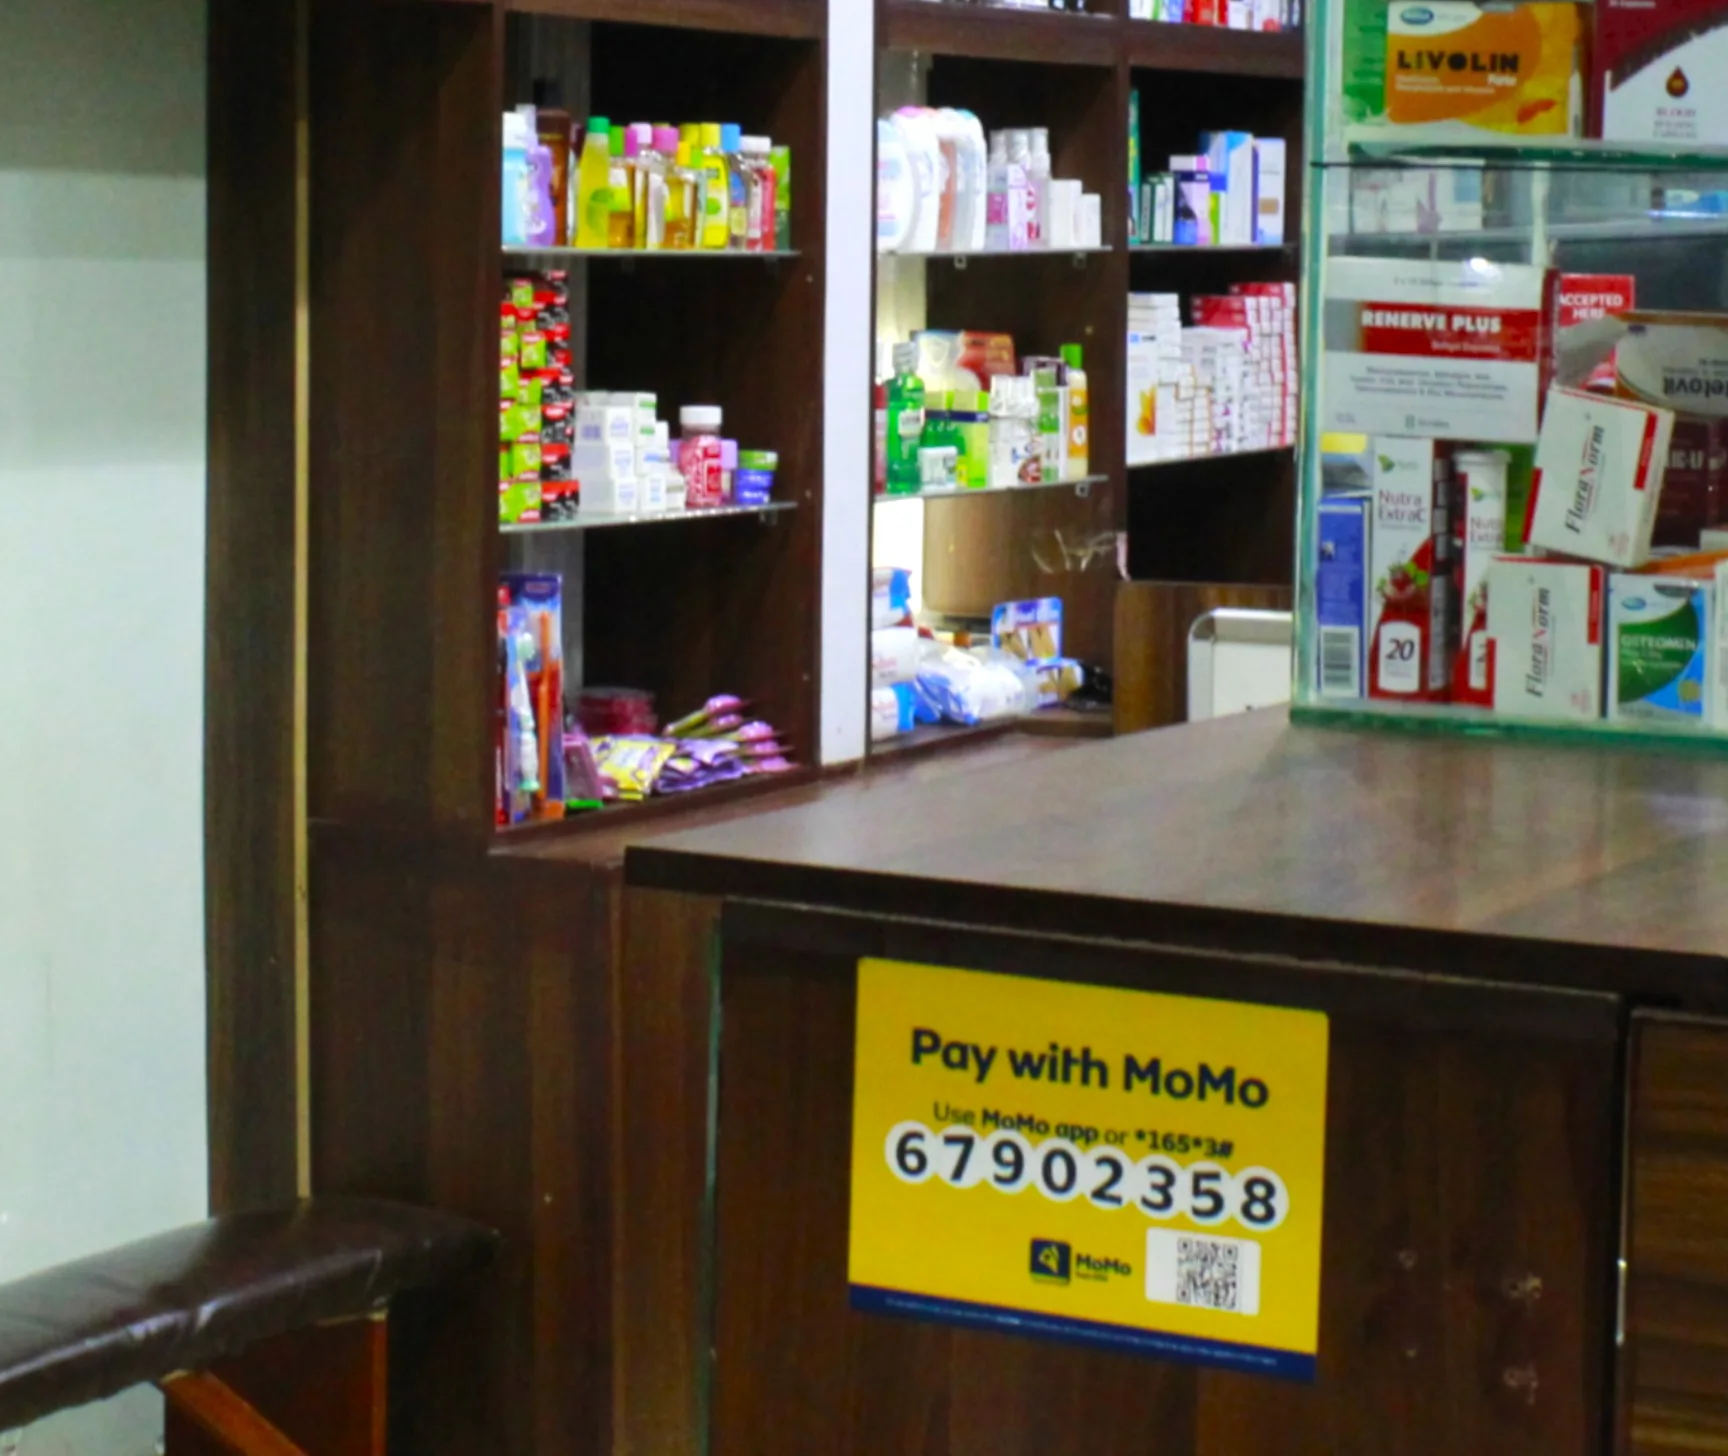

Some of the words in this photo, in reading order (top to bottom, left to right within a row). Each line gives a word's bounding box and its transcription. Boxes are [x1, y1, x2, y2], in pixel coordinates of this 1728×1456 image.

[1397, 49, 1520, 73] LIVOLIN
[1361, 310, 1447, 330] RENERVE
[1452, 315, 1501, 333] PLUS
[1379, 490, 1422, 506] Nutra
[1385, 638, 1416, 661] 20
[910, 1027, 997, 1085] Pay
[1009, 1043, 1108, 1088] with
[1123, 1054, 1269, 1109] MoMo
[933, 1101, 975, 1126] Use
[981, 1109, 1049, 1135] MoMo
[1055, 1122, 1099, 1147] app
[1103, 1127, 1129, 1147] or
[894, 1130, 1277, 1226] 67902358
[1076, 1253, 1131, 1277] MoMo
